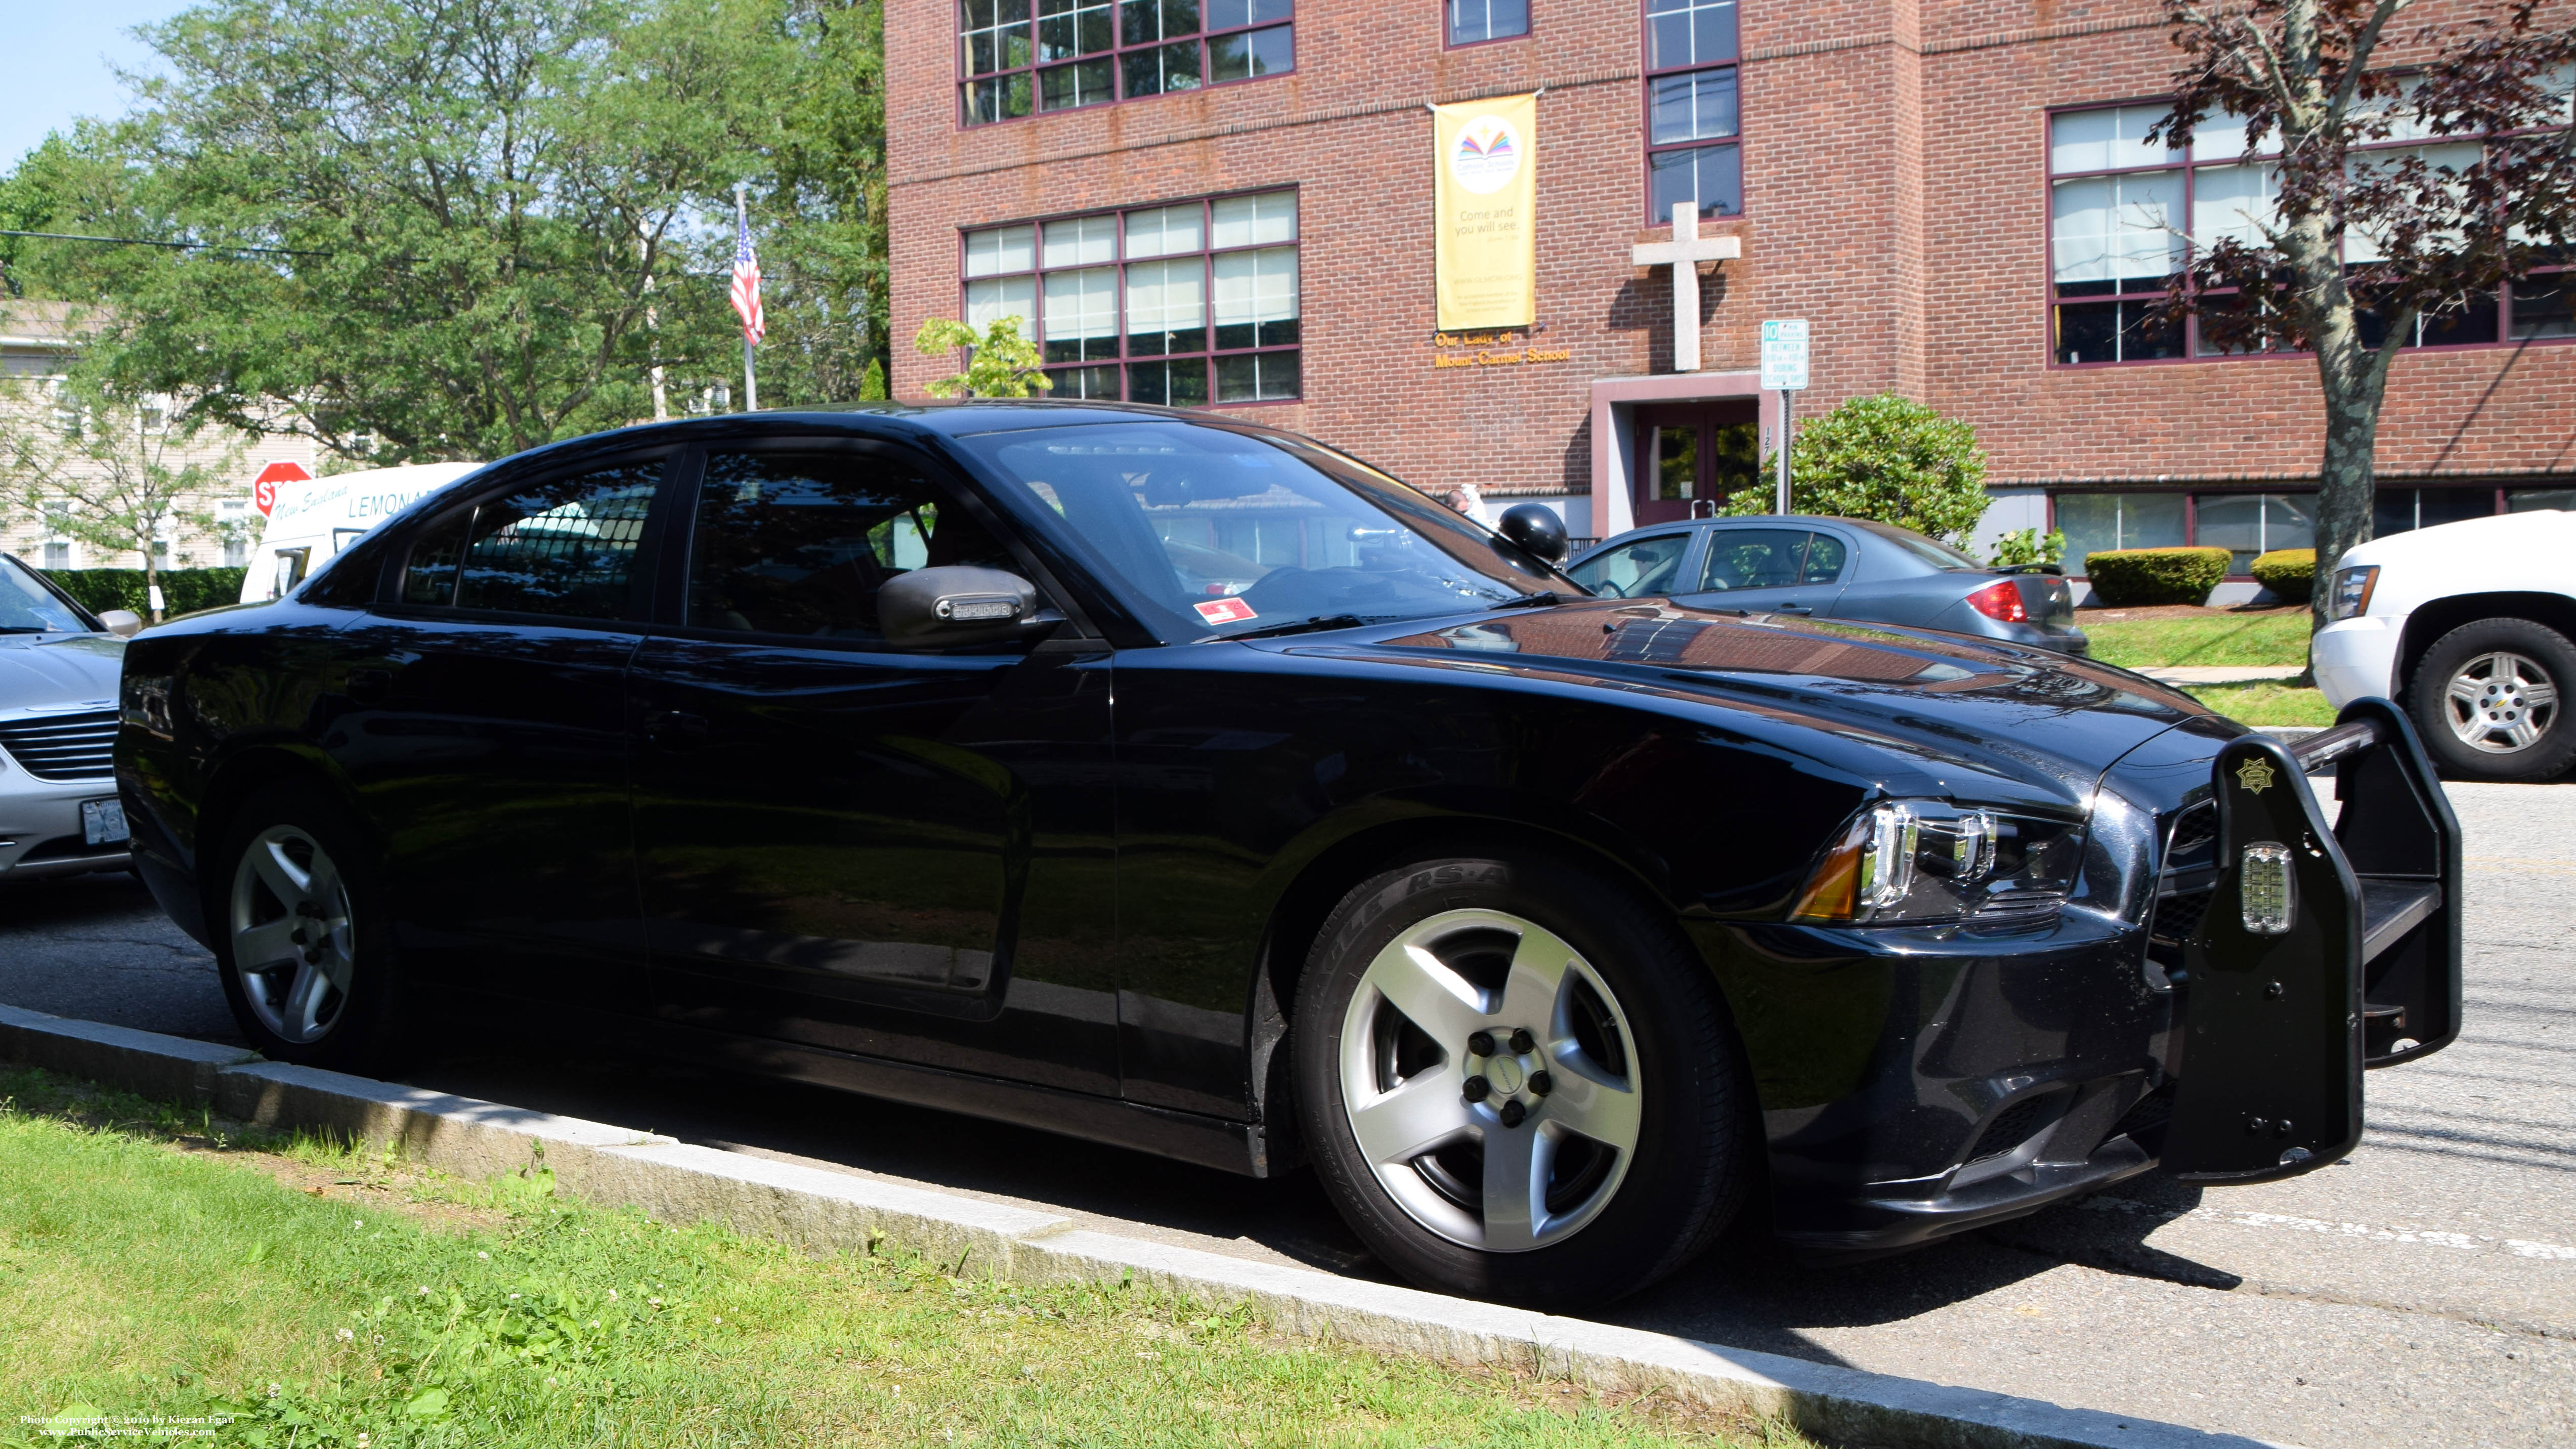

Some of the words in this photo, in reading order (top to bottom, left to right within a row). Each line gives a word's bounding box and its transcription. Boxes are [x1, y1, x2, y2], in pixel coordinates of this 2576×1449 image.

[1457, 161, 1485, 172] Catholic
[1486, 160, 1514, 168] Schools
[1461, 210, 1490, 222] Come
[1493, 206, 1514, 219] and
[1455, 226, 1474, 238] you
[1477, 221, 1495, 233] will
[1497, 222, 1520, 231] see.
[1435, 332, 1457, 347] Our
[1464, 332, 1493, 346] Lady
[1499, 331, 1512, 343] of
[1766, 325, 1778, 339] 10
[1435, 353, 1472, 368] Mount
[1477, 350, 1521, 365] Carmel
[1527, 347, 1570, 362] School
[275, 502, 298, 521] New
[302, 484, 348, 512] England
